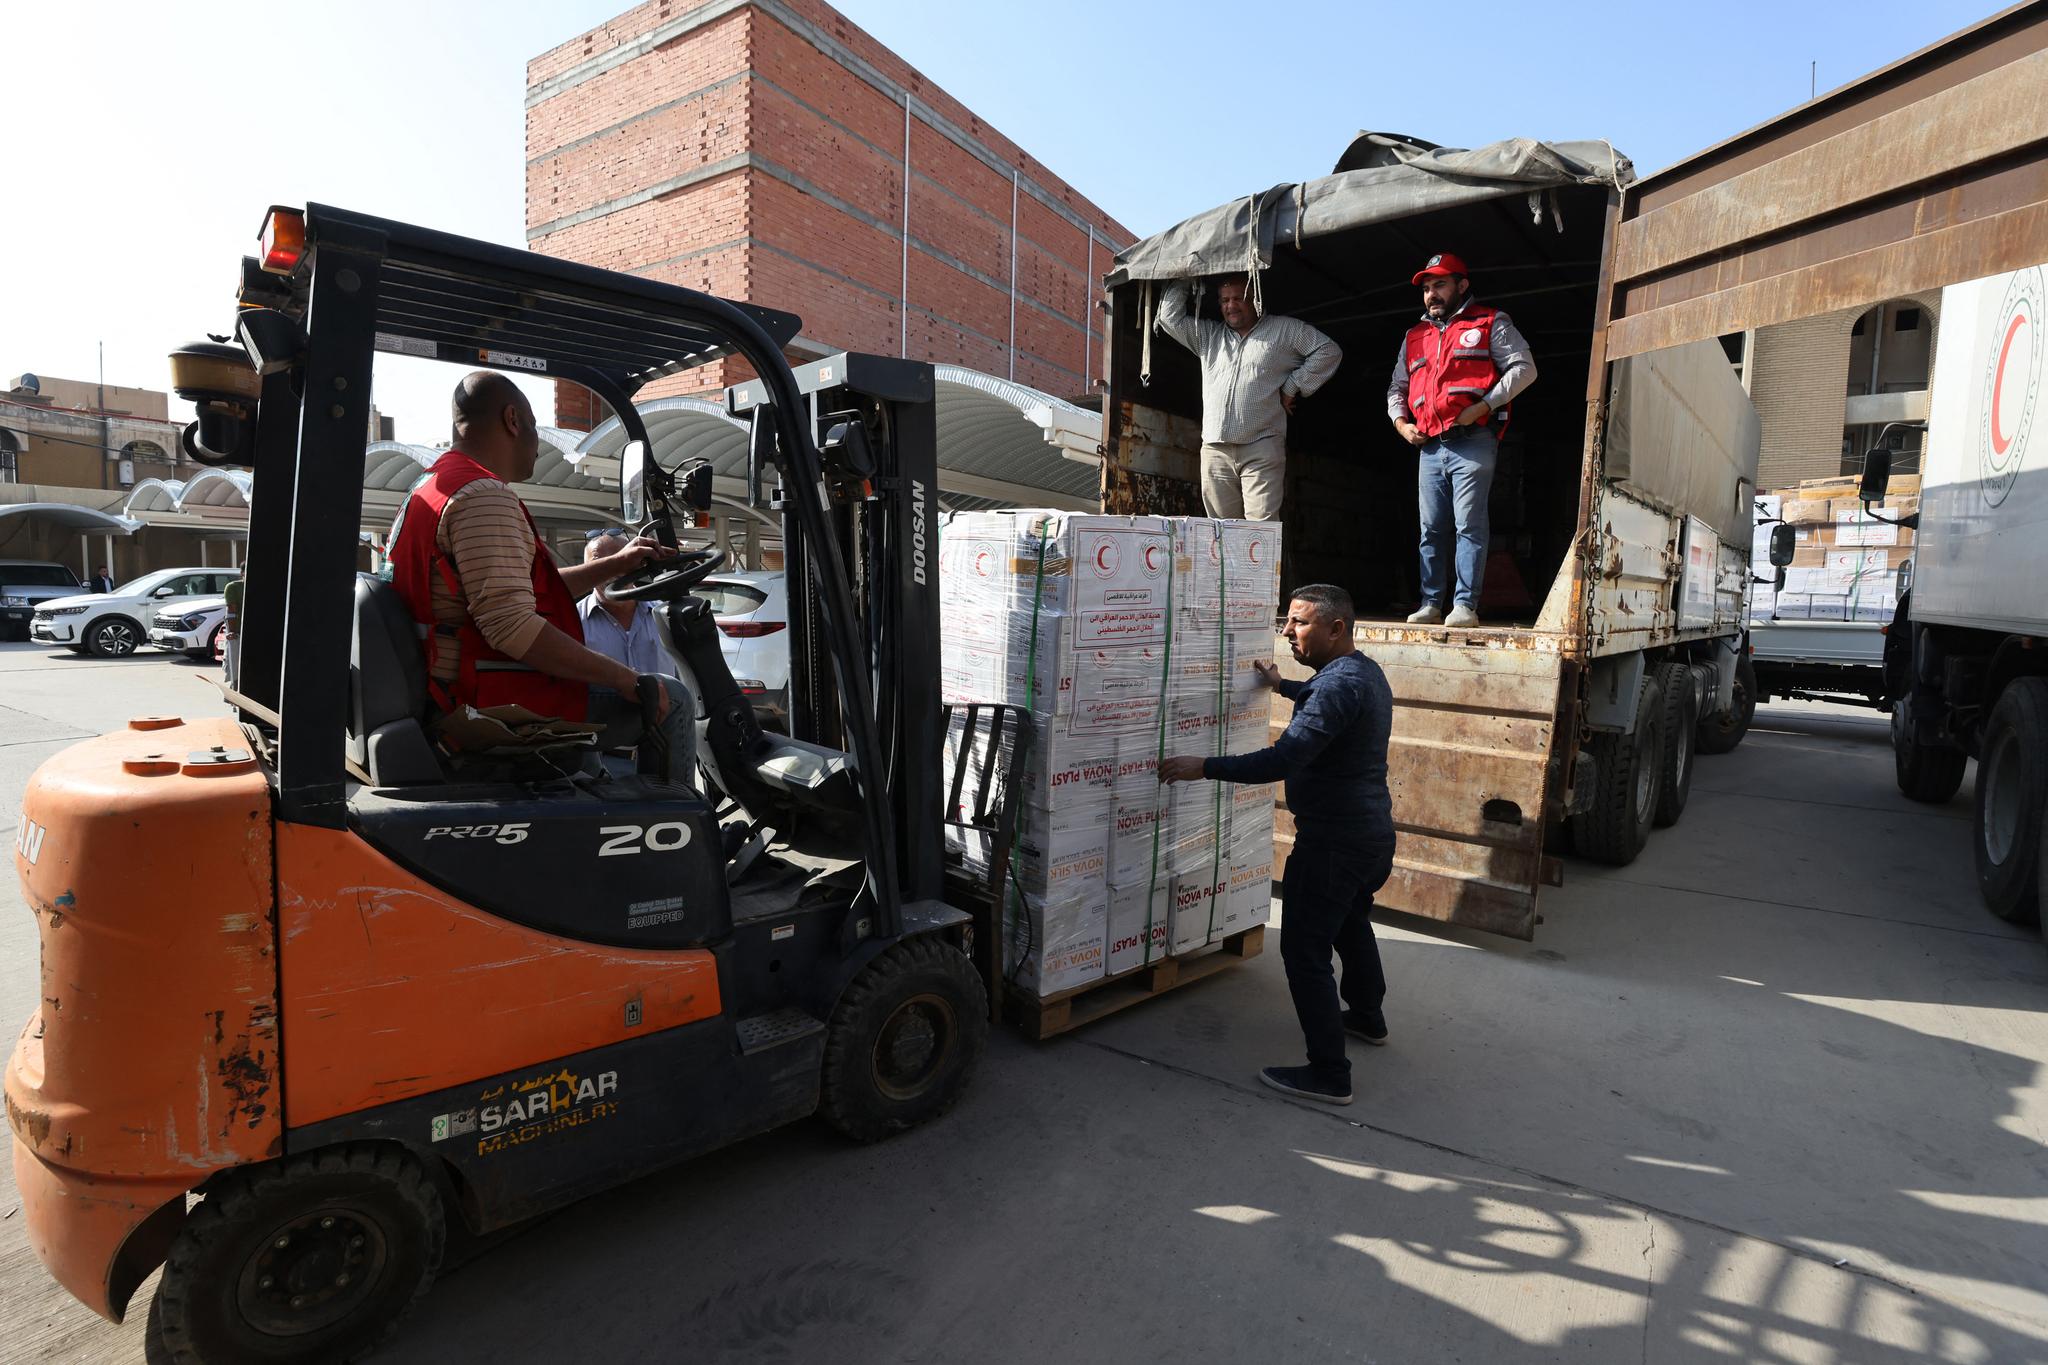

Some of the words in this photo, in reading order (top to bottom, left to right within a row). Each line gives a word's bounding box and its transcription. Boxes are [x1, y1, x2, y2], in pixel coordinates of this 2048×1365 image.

[912, 479, 926, 586] DOOSAN
[1177, 717, 1201, 731] NOVA
[1203, 713, 1226, 727] PLAT
[1051, 770, 1080, 787] PLAST
[1083, 764, 1112, 779] NOVA
[1117, 816, 1143, 830] NOVA
[423, 822, 532, 845] PRO5
[598, 821, 692, 857] 20
[1073, 856, 1104, 872] NOVA
[1230, 870, 1254, 885] NOVA
[1255, 864, 1271, 876] SILK
[1177, 890, 1202, 907] NOVA
[628, 910, 684, 929] EQUIPPED
[1111, 934, 1138, 954] PLAST
[1140, 926, 1166, 945] NOA
[1070, 946, 1102, 966] NOVA
